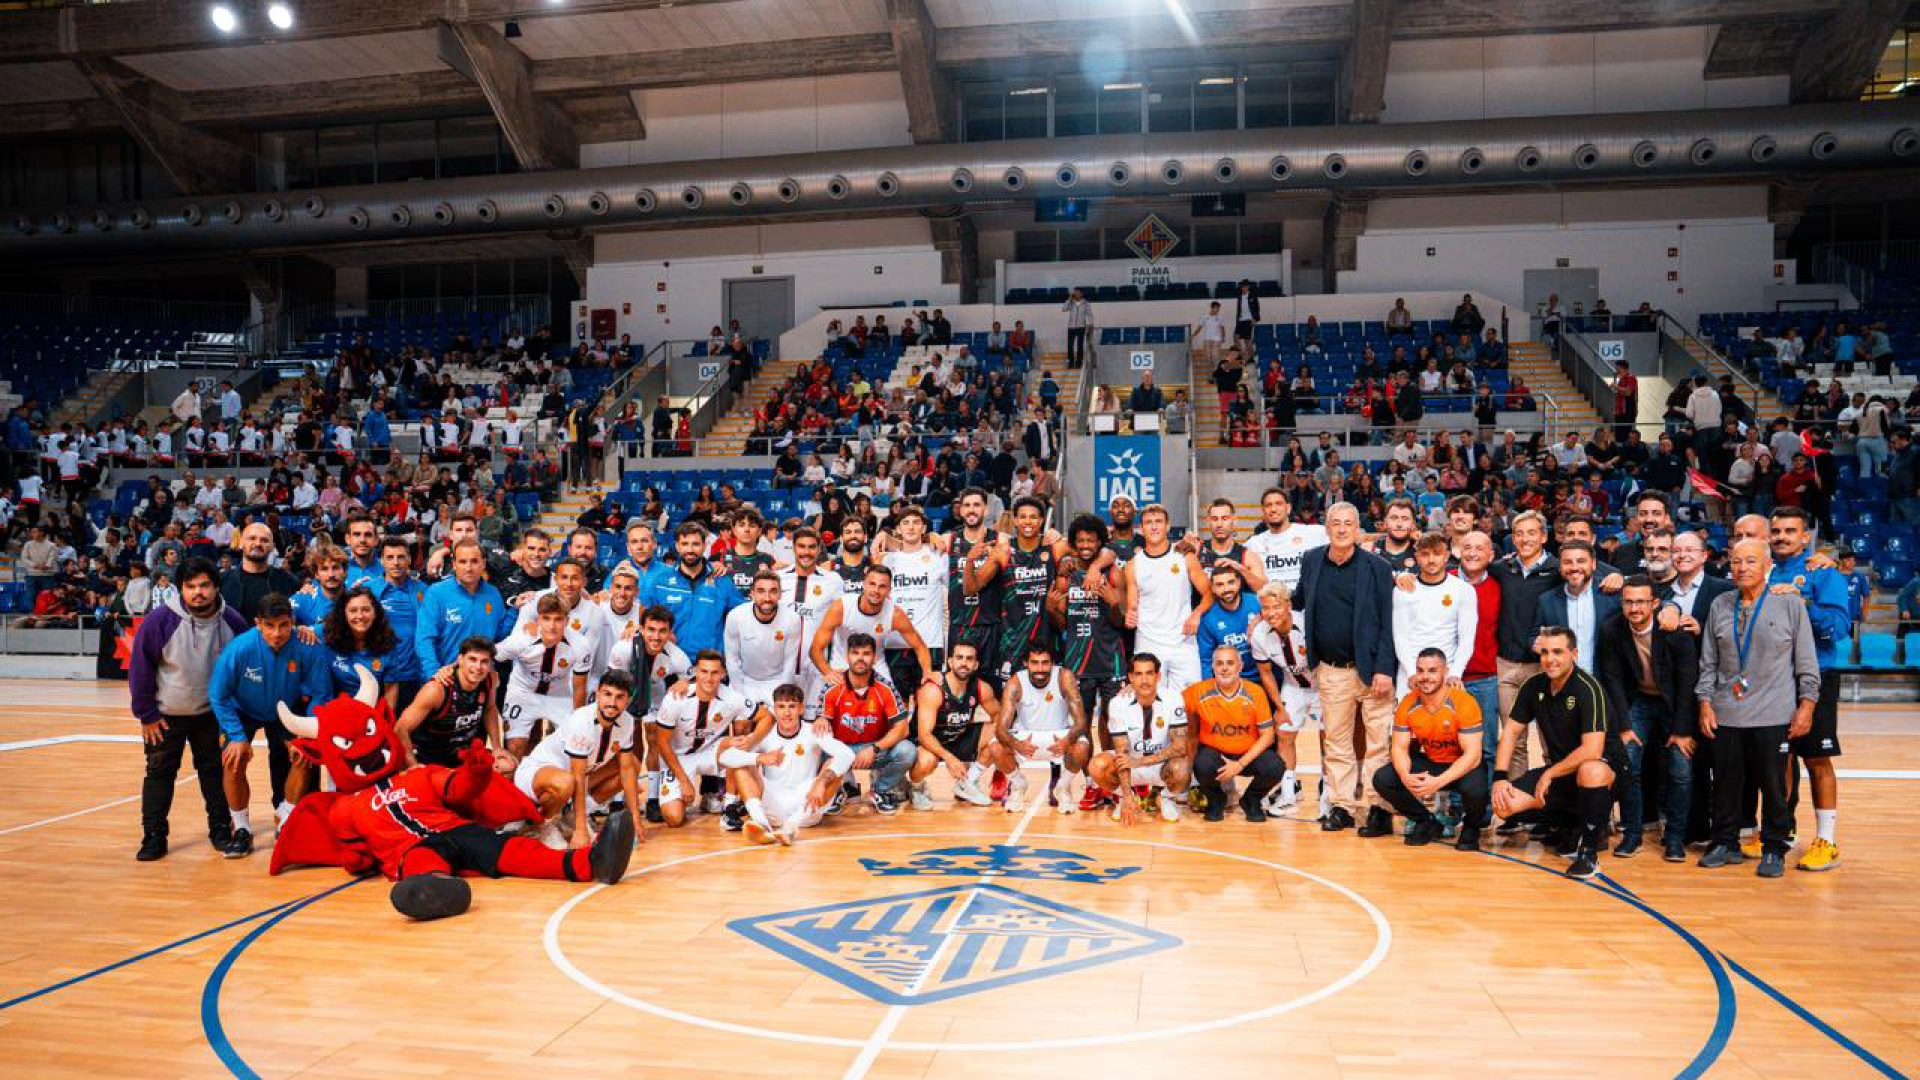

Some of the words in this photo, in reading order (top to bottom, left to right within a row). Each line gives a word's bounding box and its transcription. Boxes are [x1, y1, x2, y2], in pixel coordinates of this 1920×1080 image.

[1132, 267, 1170, 275] PALMA
[1133, 354, 1152, 367] 05
[701, 365, 717, 378] 04
[1099, 476, 1157, 502] IME
[1014, 564, 1047, 580] fibwi
[893, 572, 928, 588] fibwi
[1025, 601, 1041, 615] 34
[1077, 623, 1091, 637] 33
[1211, 722, 1250, 737] AON
